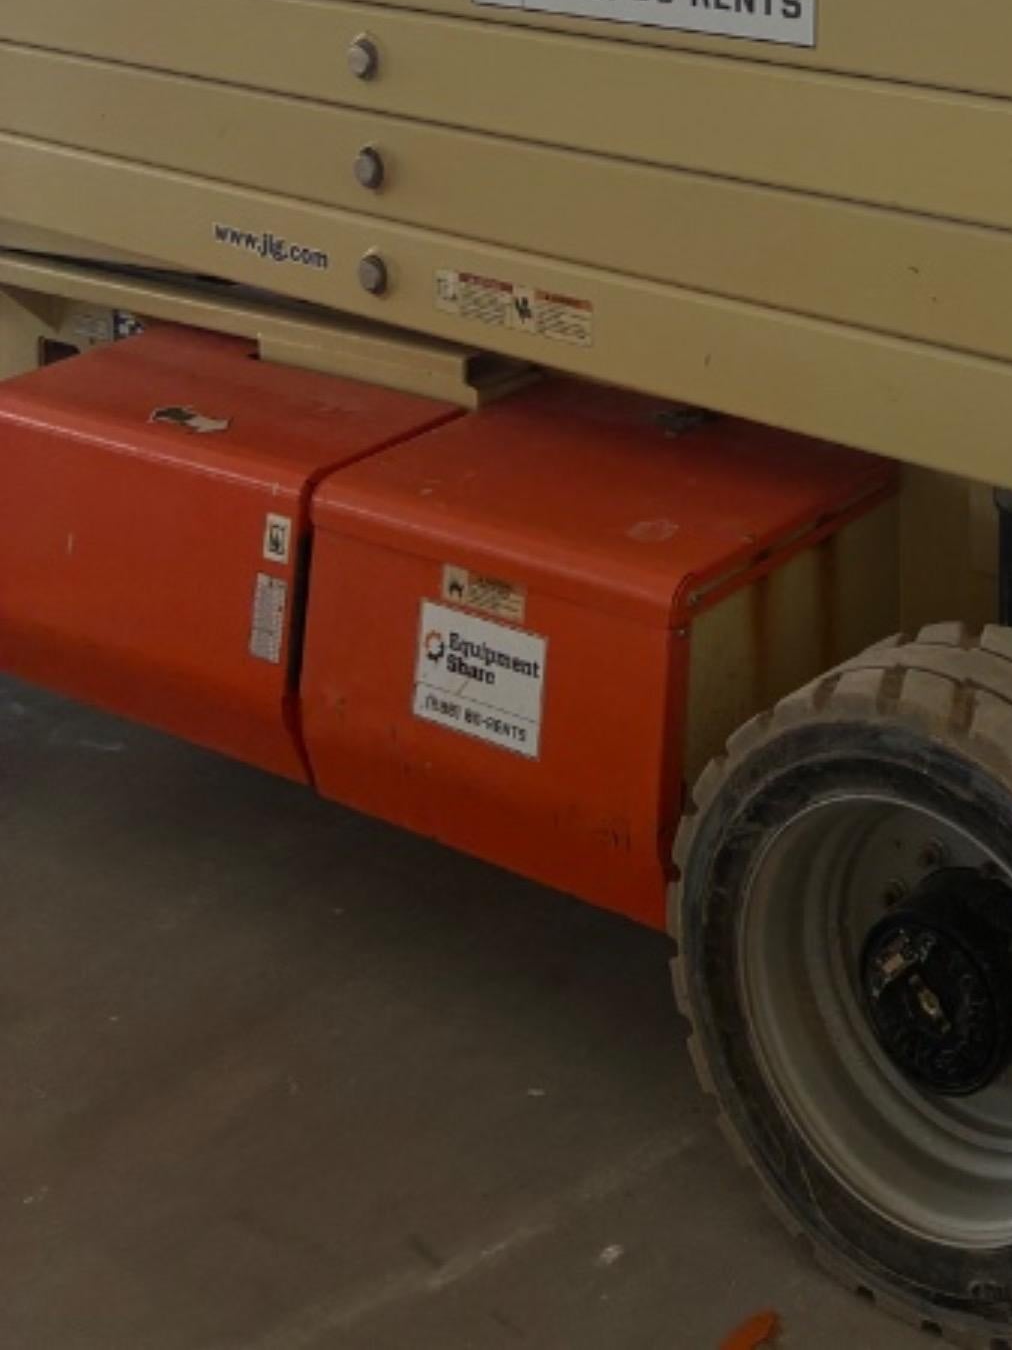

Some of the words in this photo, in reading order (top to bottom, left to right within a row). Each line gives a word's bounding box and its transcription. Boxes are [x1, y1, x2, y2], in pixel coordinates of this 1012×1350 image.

[214, 224, 329, 269] www.jlg.com
[446, 654, 496, 684] Share
[448, 632, 540, 678] Equipment
